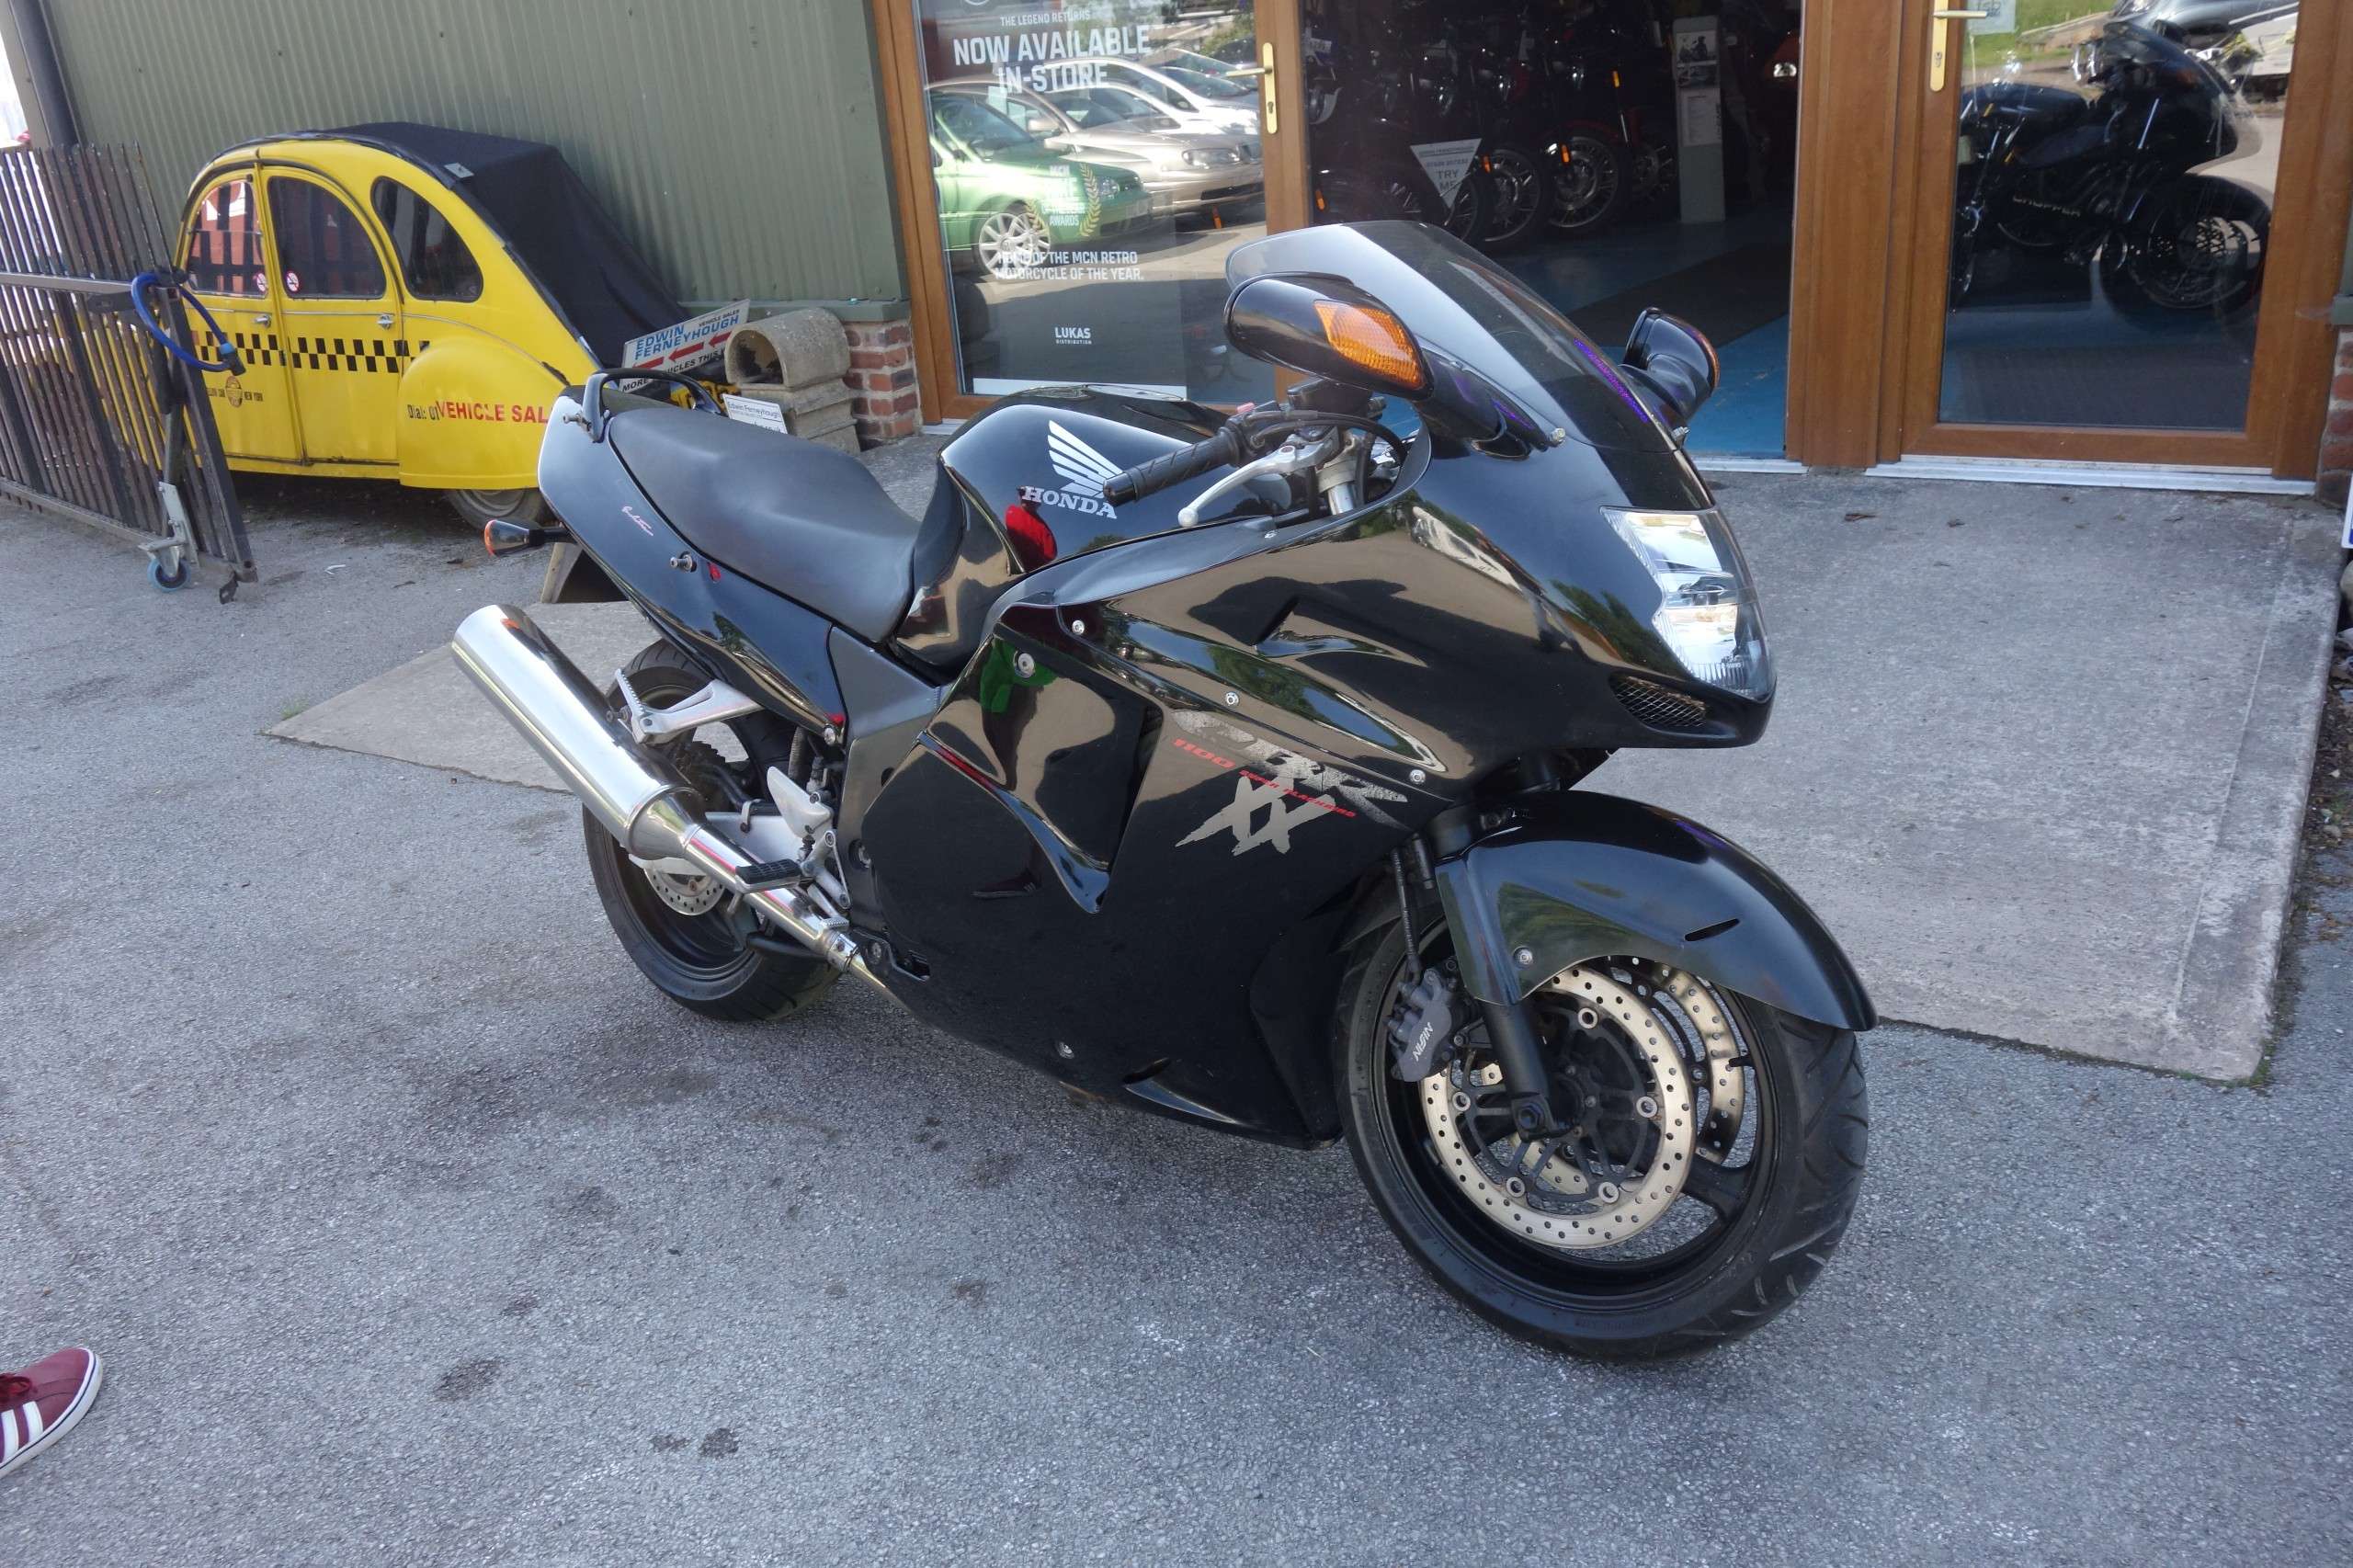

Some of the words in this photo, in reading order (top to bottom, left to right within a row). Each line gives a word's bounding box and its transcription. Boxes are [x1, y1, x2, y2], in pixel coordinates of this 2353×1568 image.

[1000, 16, 1016, 27] THE
[1017, 13, 1050, 25] LEGEND
[1051, 9, 1091, 23] RETURNS
[953, 35, 1010, 66] NOW
[1017, 25, 1150, 62] AVAILABLE
[998, 63, 1108, 94] IN-STORE
[1049, 214, 1080, 226] AWARDS
[1032, 251, 1045, 264] OF
[1049, 252, 1070, 264] THE
[1072, 252, 1098, 264] MCN
[1100, 251, 1138, 264] RETRO
[995, 267, 1068, 280] MOTORCYCLE
[1070, 267, 1086, 279] OF
[1087, 267, 1108, 279] THE
[1110, 267, 1145, 280] YEAR.
[634, 314, 740, 361] FERNEYHOUGH
[636, 324, 685, 349] EDWIN
[1054, 327, 1092, 339] LUKAS
[621, 378, 649, 392] MORE
[437, 400, 505, 422] VEHICLE
[1021, 485, 1118, 519] HONDA
[1172, 738, 1236, 768] 1100
[1175, 774, 1337, 857] XX
[1412, 1021, 1432, 1062] NISSIN
